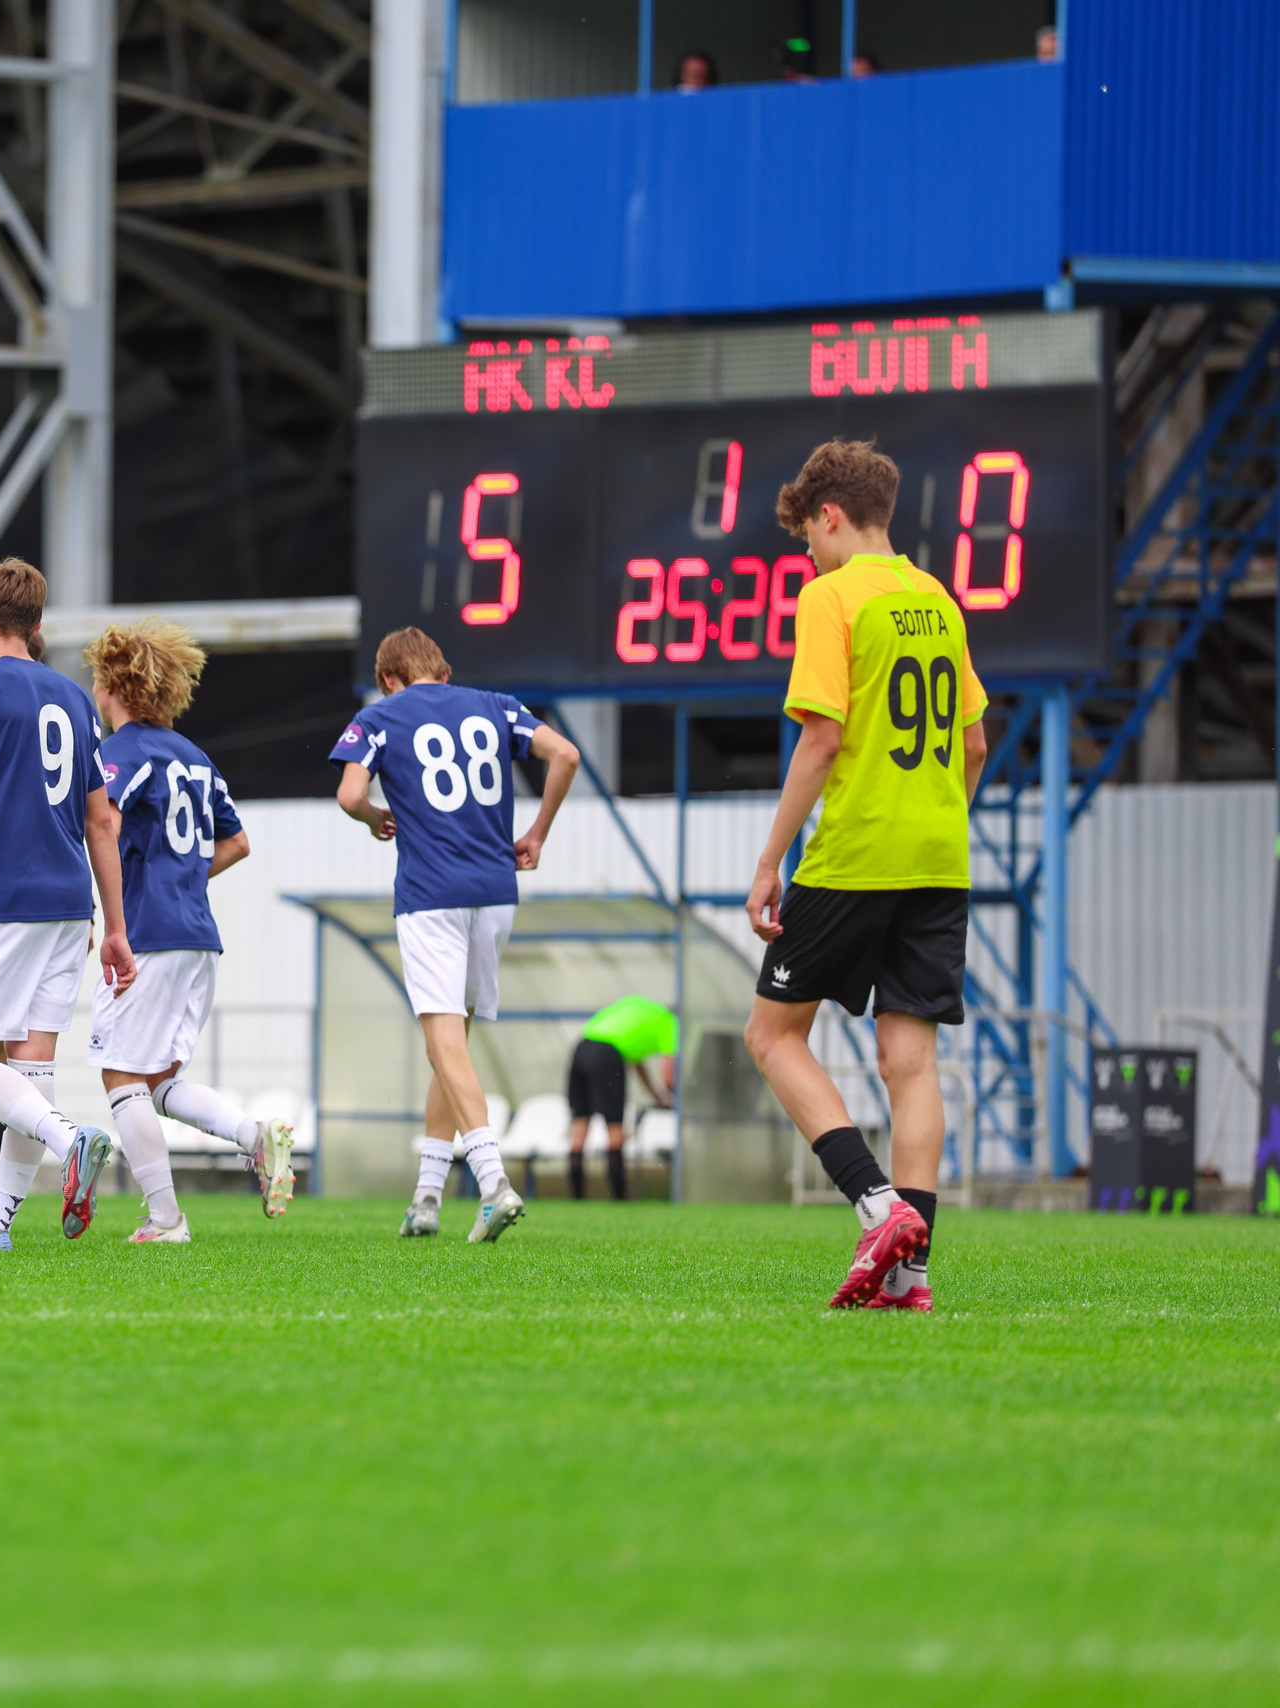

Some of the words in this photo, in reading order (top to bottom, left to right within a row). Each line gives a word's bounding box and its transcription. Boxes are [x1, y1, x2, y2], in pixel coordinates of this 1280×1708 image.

[721, 440, 743, 533] 1
[952, 450, 1030, 611] 0
[460, 472, 520, 625] 5
[616, 554, 817, 663] 25:28
[889, 609, 949, 636] ВОЛГА
[38, 703, 74, 806] 9
[413, 715, 503, 813] 88
[888, 656, 957, 771] 99
[165, 760, 215, 859] 63
